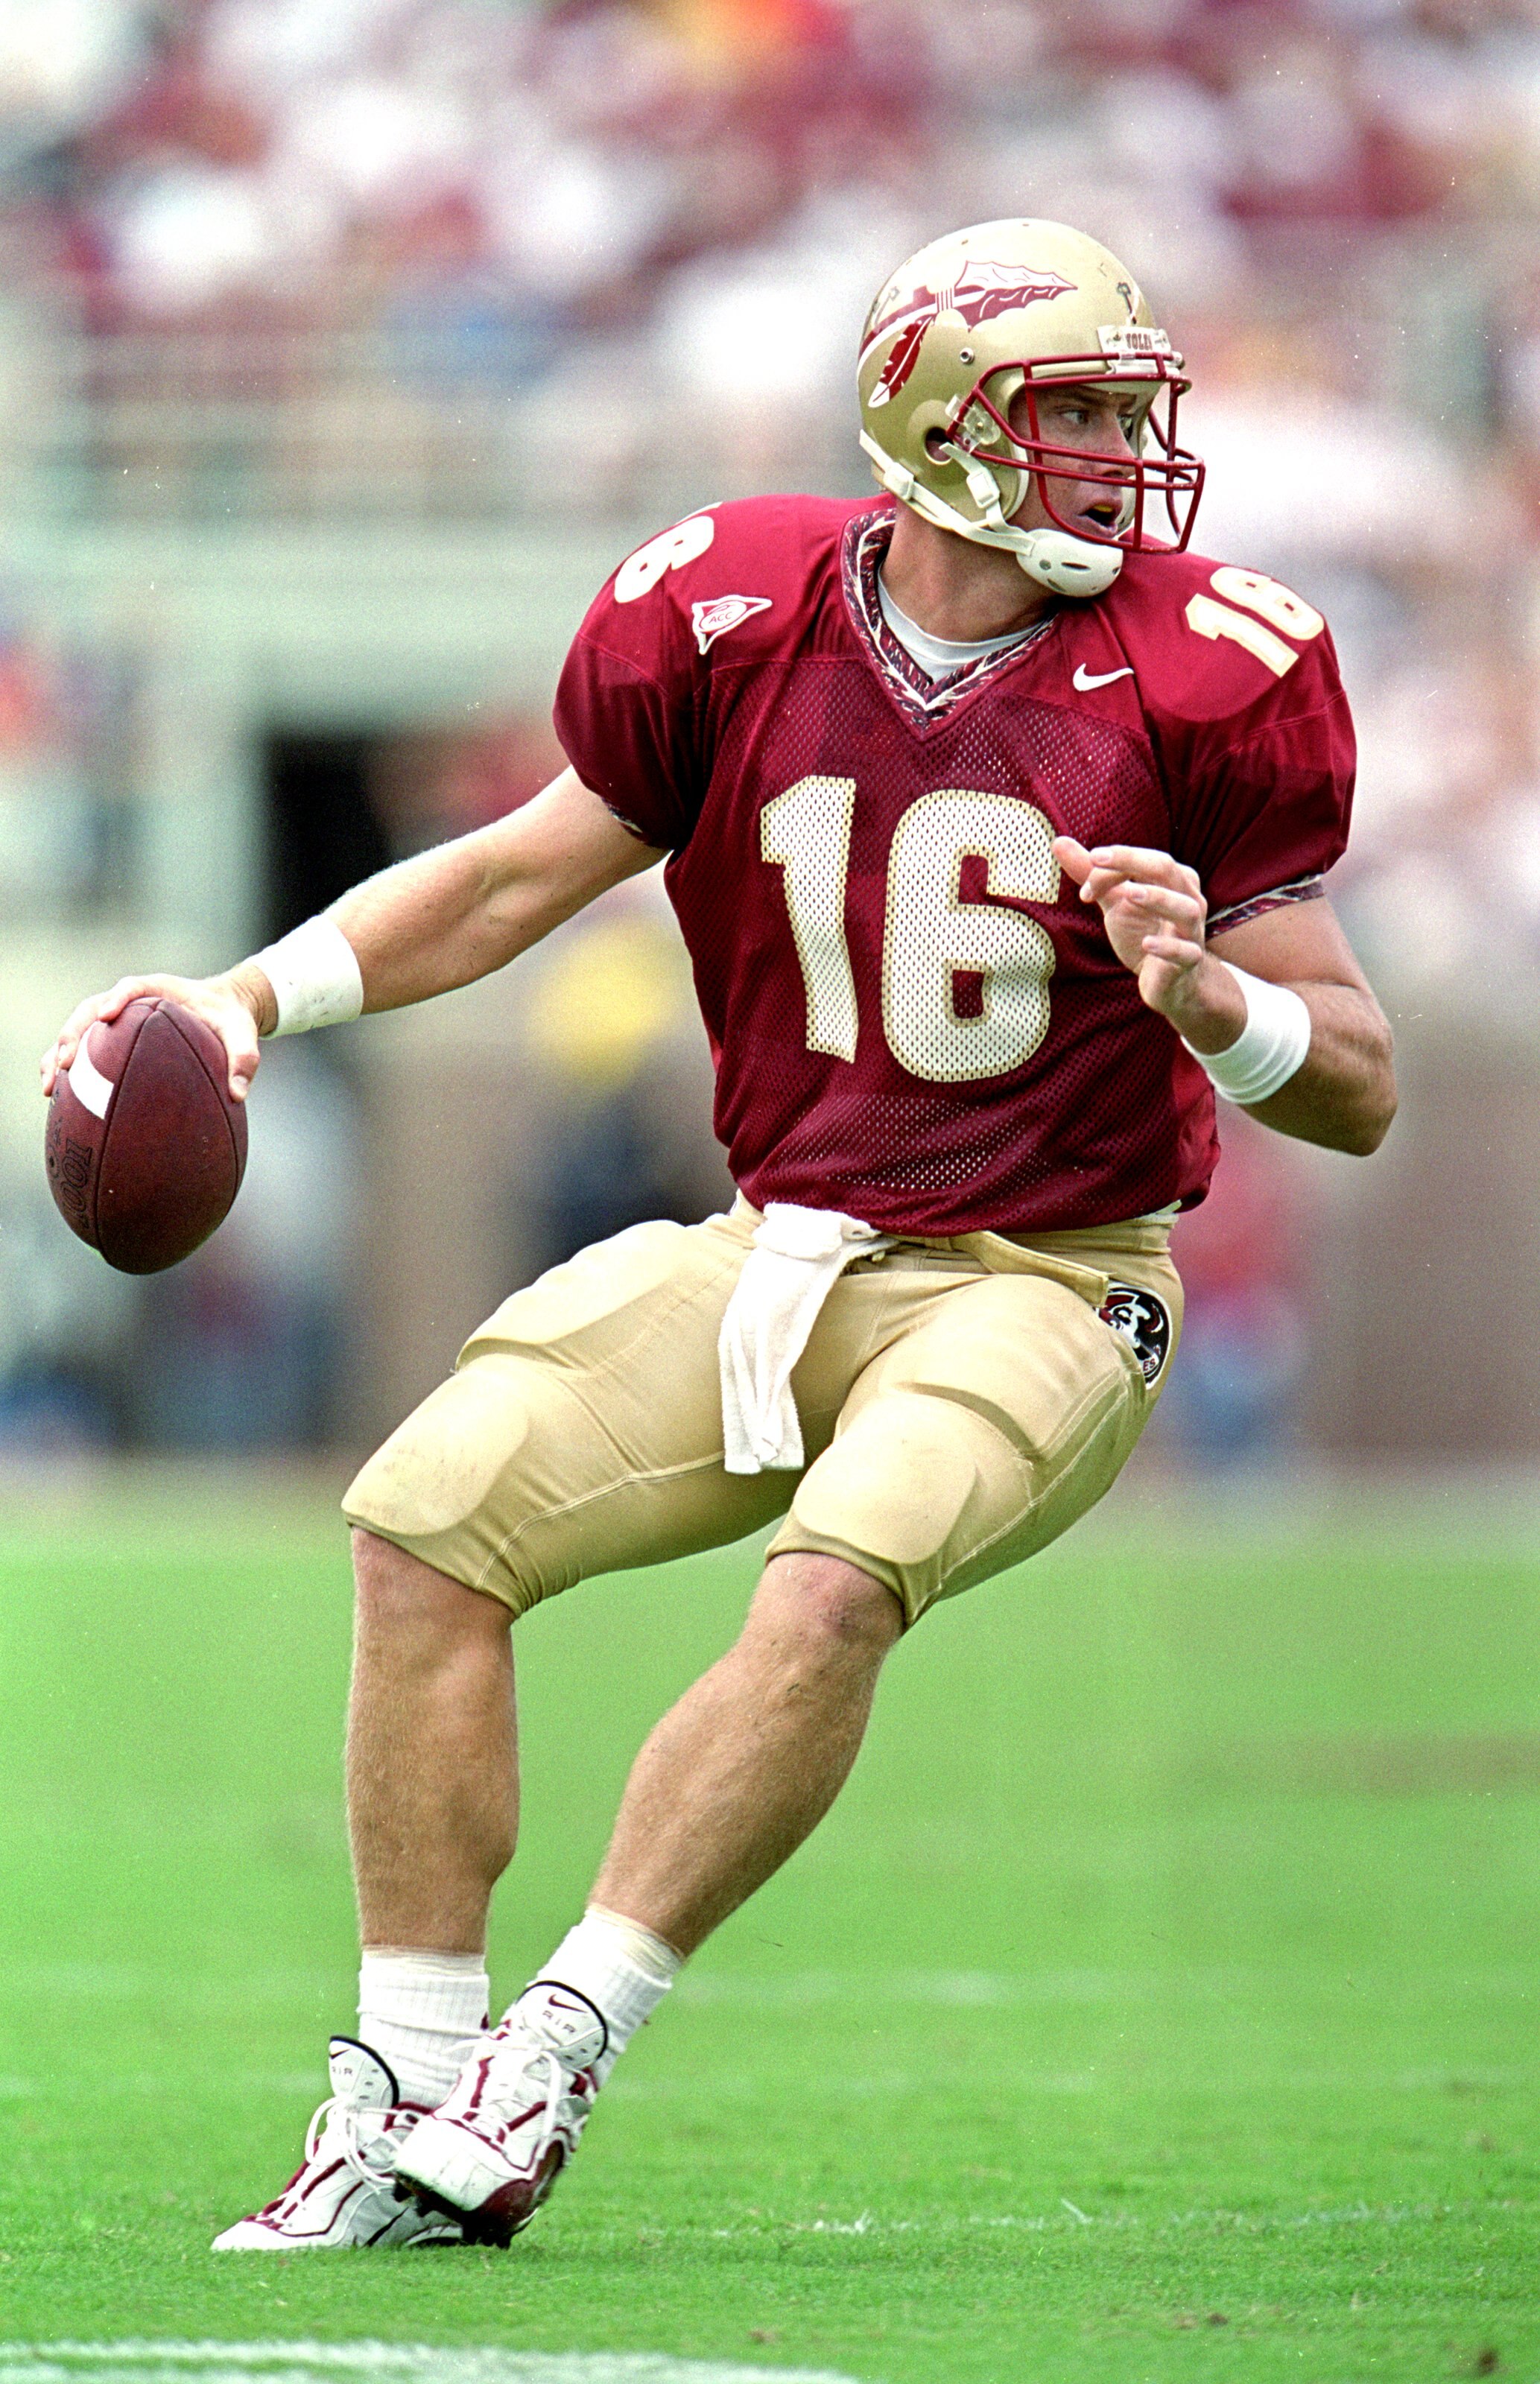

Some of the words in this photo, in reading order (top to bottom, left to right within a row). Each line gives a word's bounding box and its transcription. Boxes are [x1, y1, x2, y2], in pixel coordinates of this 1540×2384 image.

[709, 612, 733, 624] ACC
[1185, 566, 1325, 678] 16
[760, 775, 1062, 1082] 16
[542, 2010, 577, 2035] AIR
